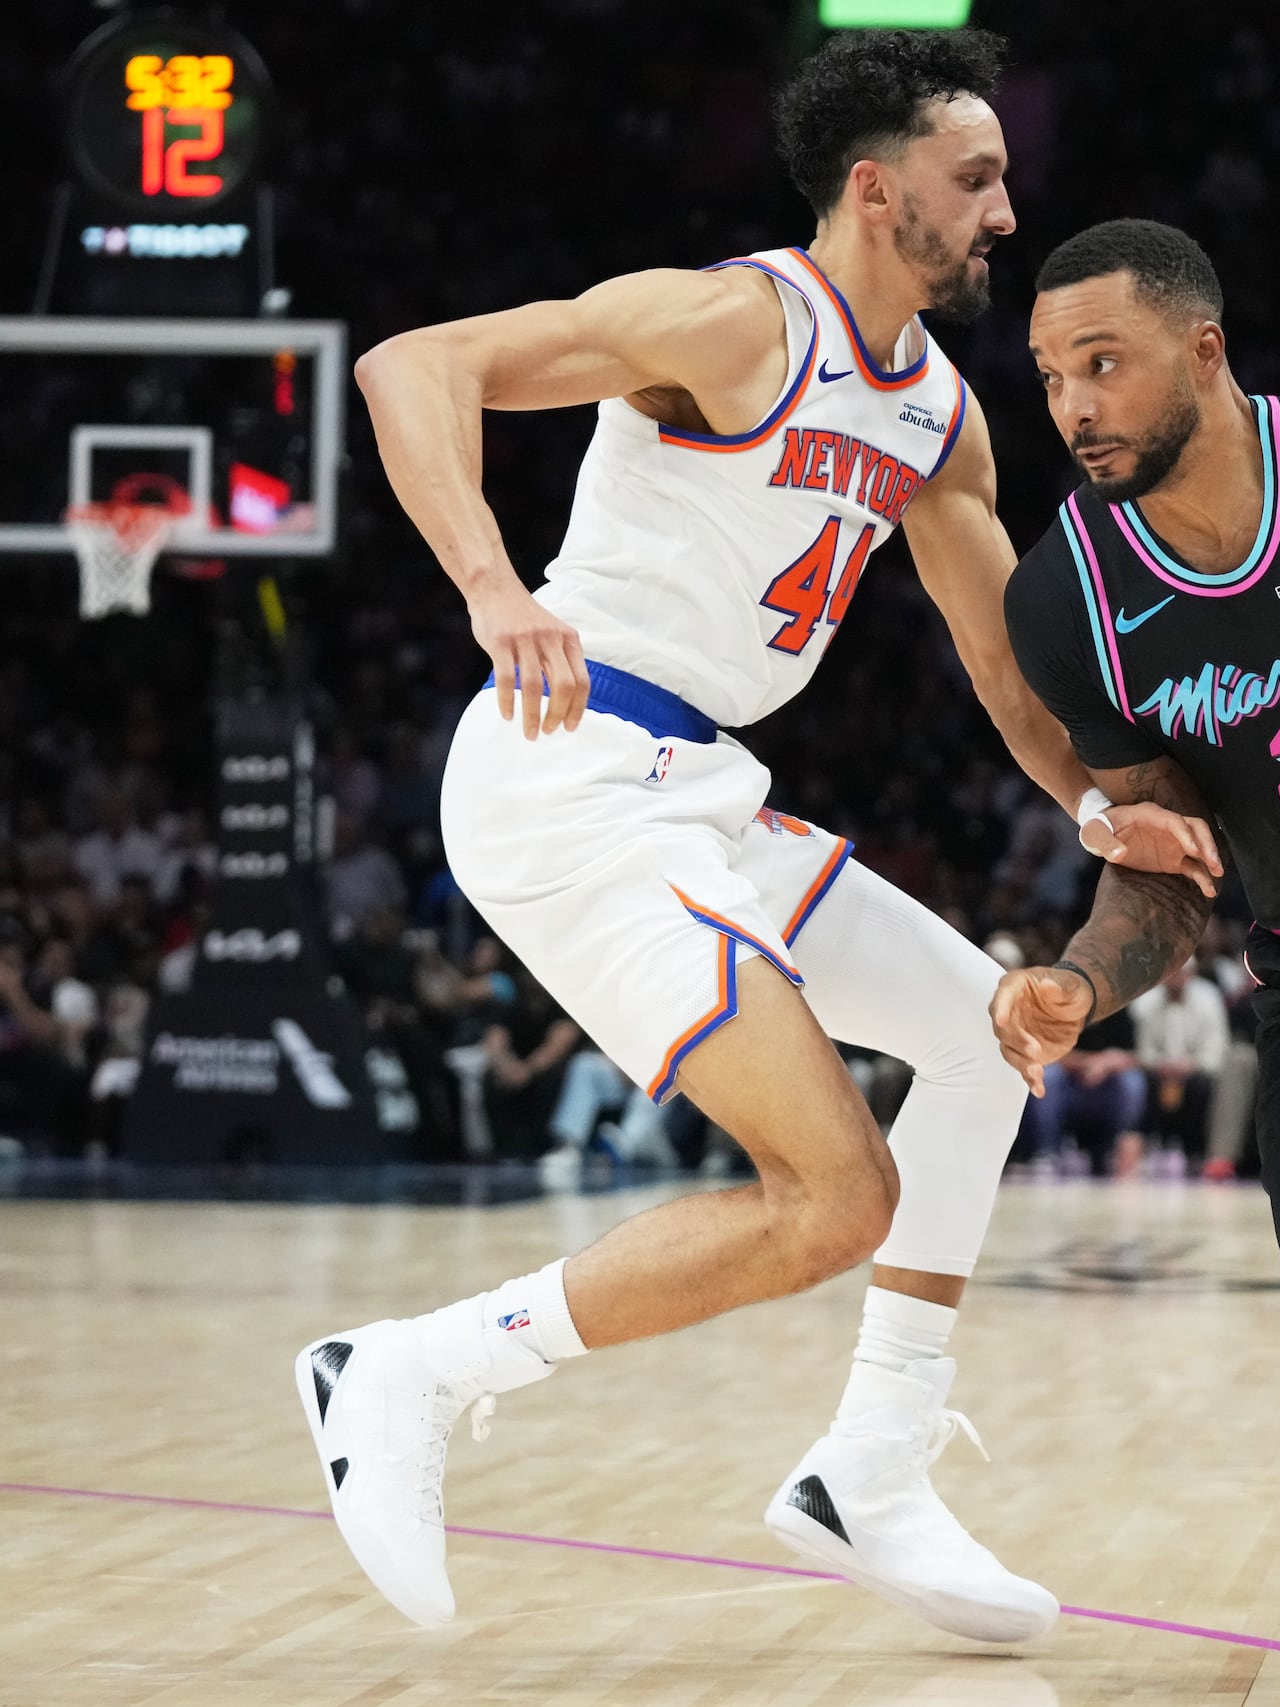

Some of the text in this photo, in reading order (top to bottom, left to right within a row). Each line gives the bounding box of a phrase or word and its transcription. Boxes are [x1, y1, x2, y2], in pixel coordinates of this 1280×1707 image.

[142, 107, 224, 197] 12
[899, 410, 948, 434] abu dhab
[903, 402, 933, 417] experience
[767, 427, 862, 498] NEW
[759, 514, 877, 657] 44
